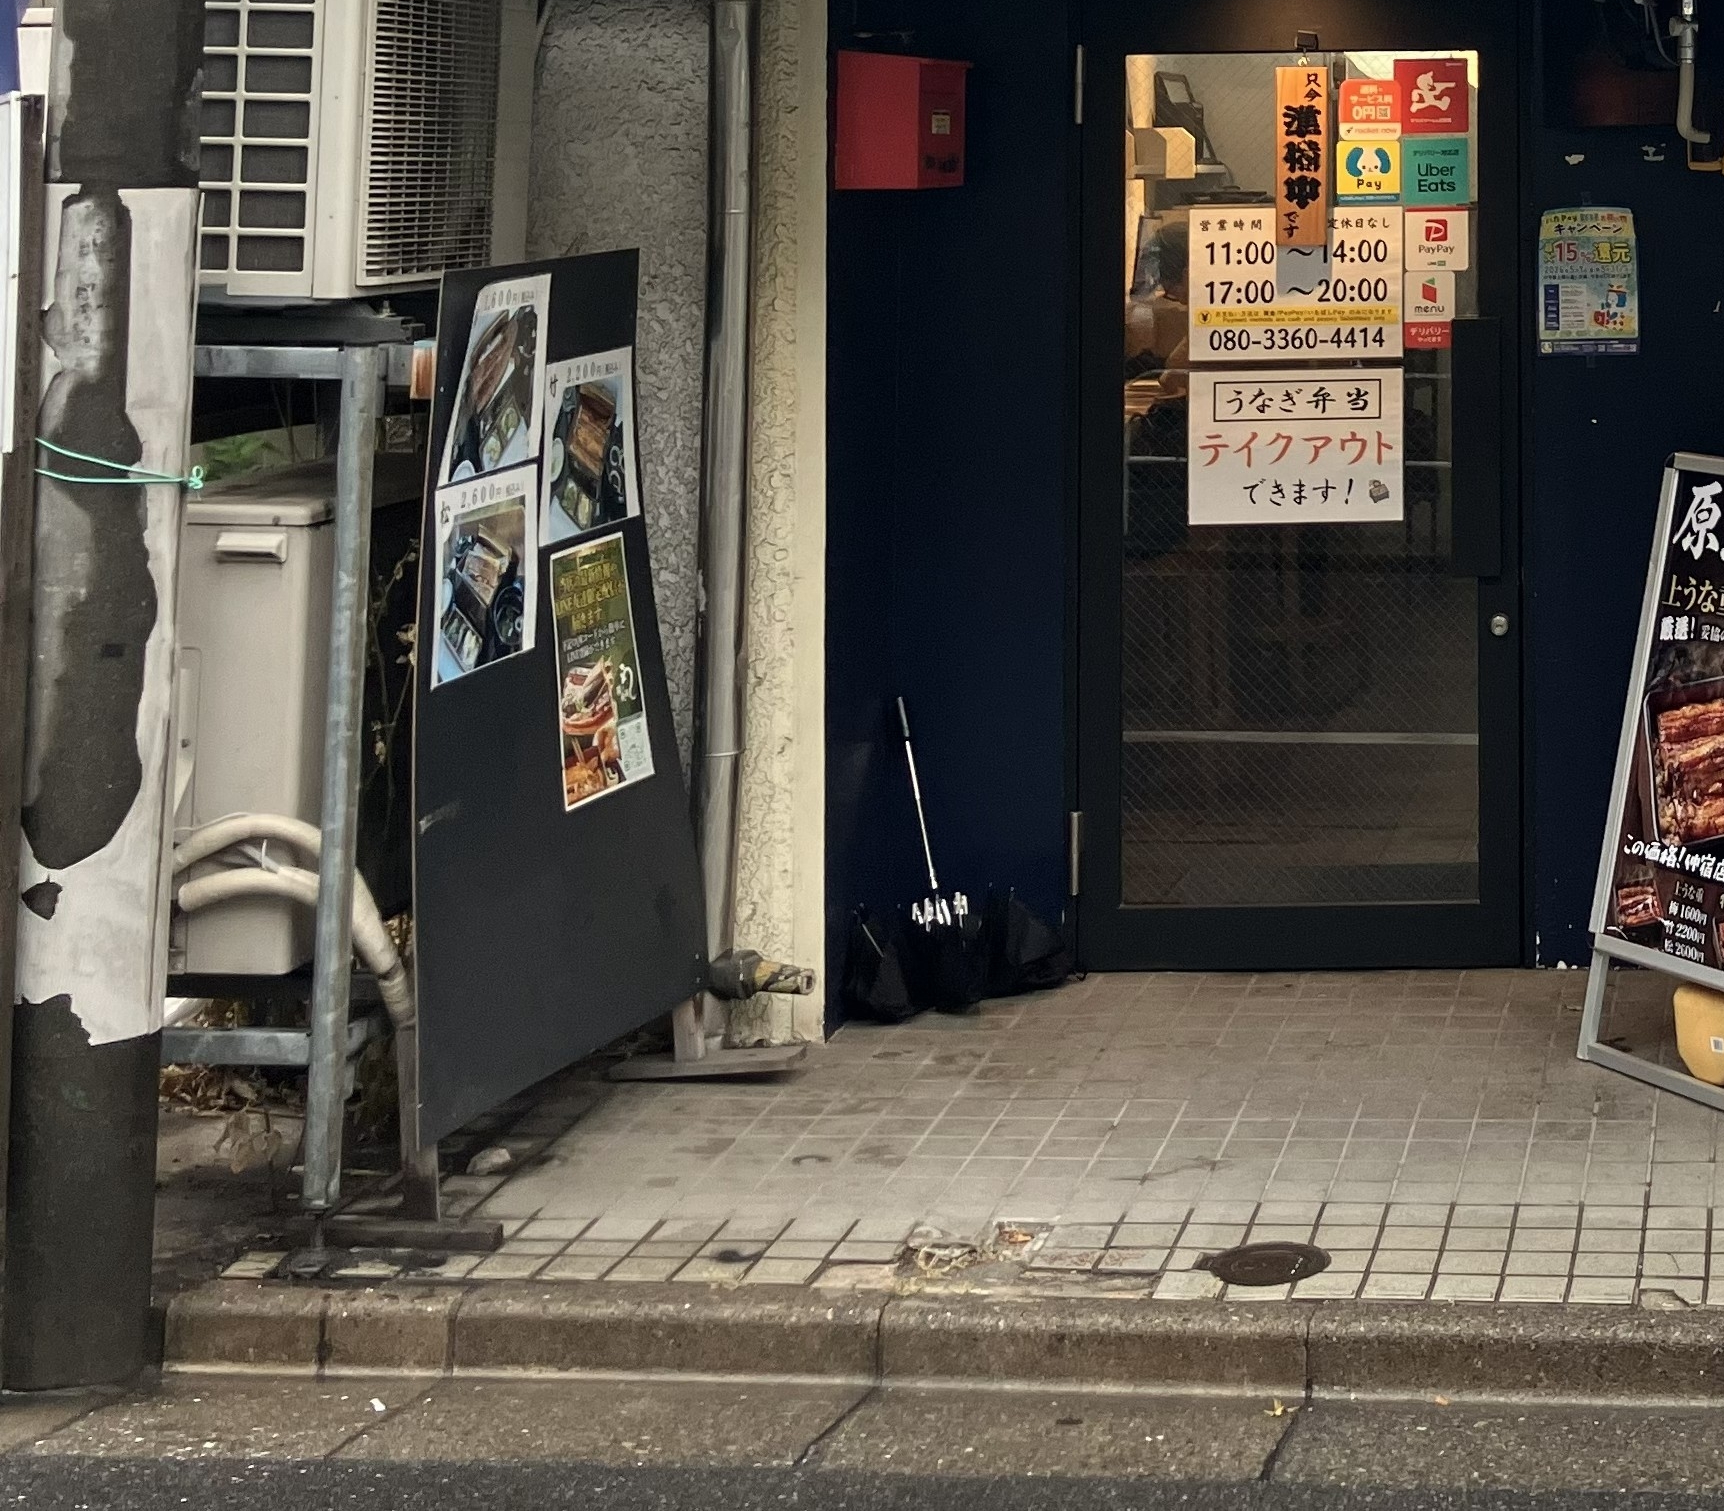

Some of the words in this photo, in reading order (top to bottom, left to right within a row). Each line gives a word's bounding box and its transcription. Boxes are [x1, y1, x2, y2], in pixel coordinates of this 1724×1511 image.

[1304, 73, 1323, 102] 只今
[1352, 105, 1376, 120] 0円
[1282, 104, 1322, 210] 準備中
[1417, 163, 1456, 177] Uber
[1357, 178, 1382, 190] Pay
[1417, 179, 1456, 193] Eats
[1200, 219, 1263, 232] 営業時間
[1283, 211, 1299, 238] です
[1328, 217, 1391, 230] 定休日なし
[1554, 223, 1623, 236] キャンペーン
[1418, 244, 1455, 255] PayPay
[1414, 305, 1445, 314] menu
[1410, 326, 1450, 336] デリバリー
[1209, 326, 1386, 352] 080-3360-4414
[1226, 386, 1369, 414] うなぎ弁当
[1199, 431, 1393, 467] テイクアウト
[1243, 478, 1353, 506] できます!
